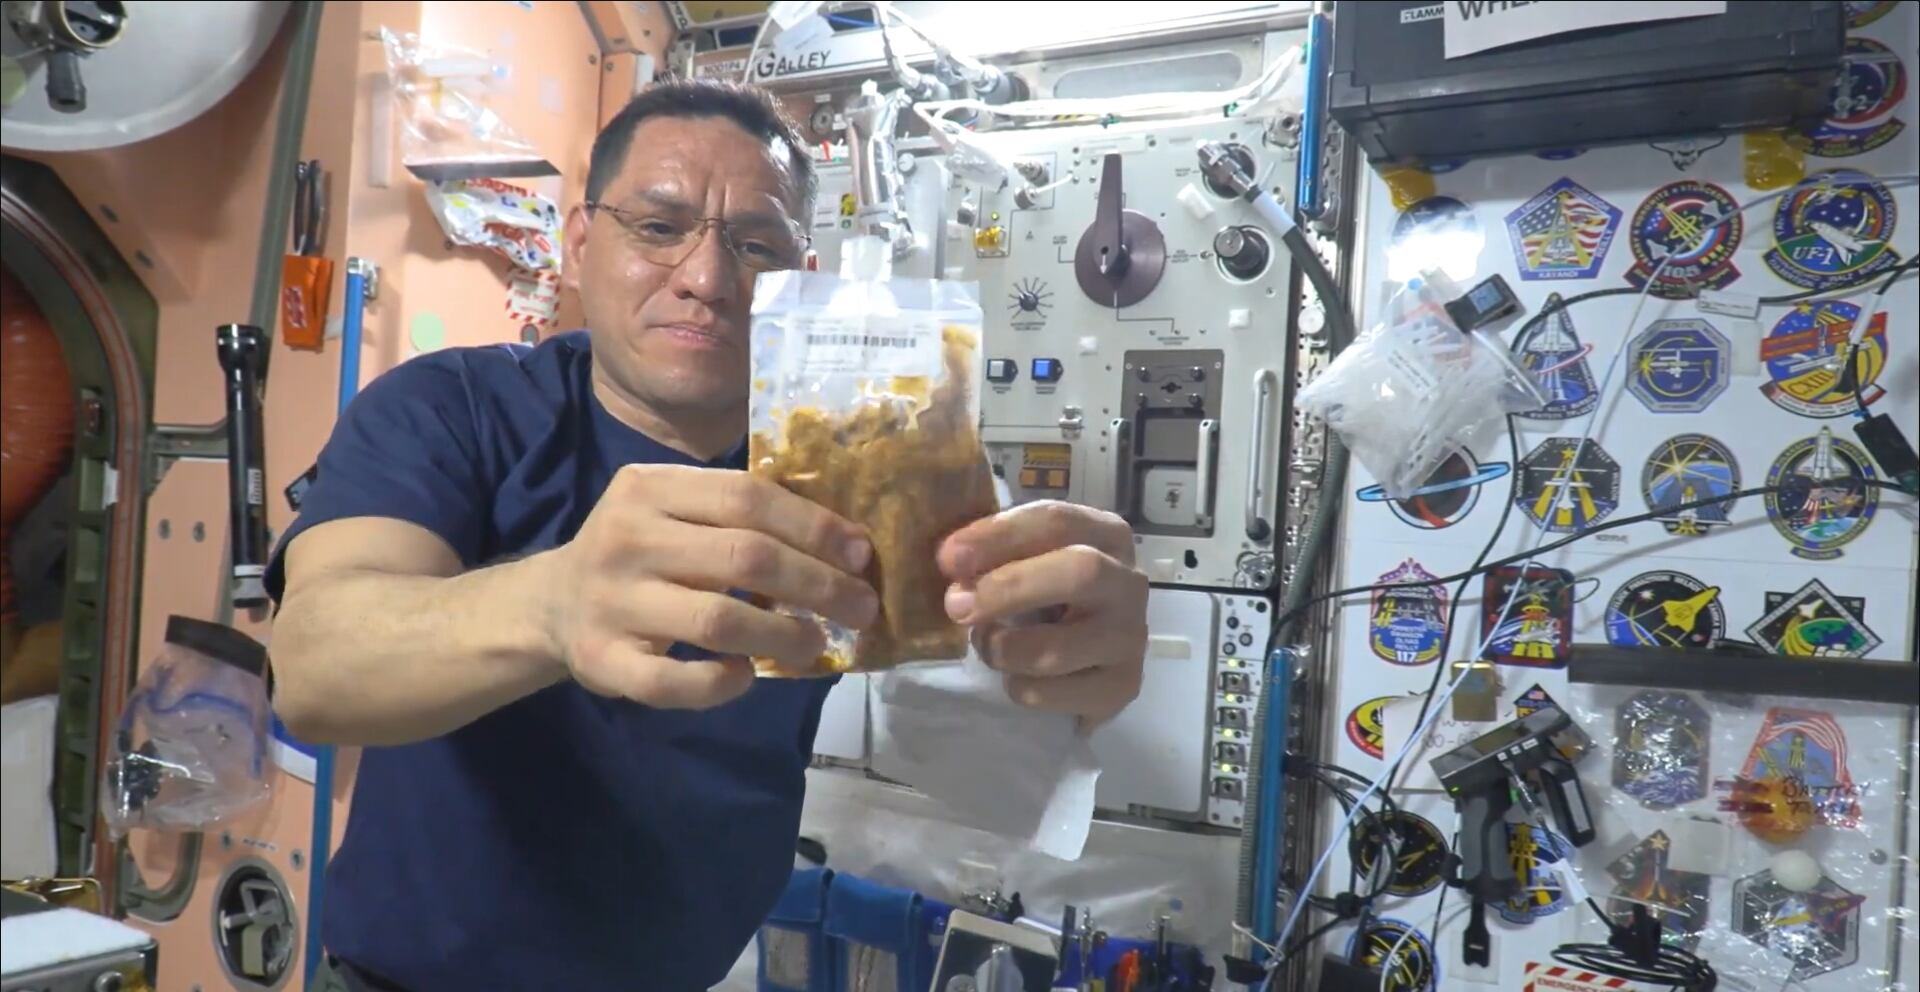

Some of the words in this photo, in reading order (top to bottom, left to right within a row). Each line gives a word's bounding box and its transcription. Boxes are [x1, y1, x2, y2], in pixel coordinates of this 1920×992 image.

[757, 50, 832, 78] GALLEY
[1793, 247, 1833, 265] UF-1
[1664, 265, 1701, 280] 105
[1396, 650, 1418, 663] 117
